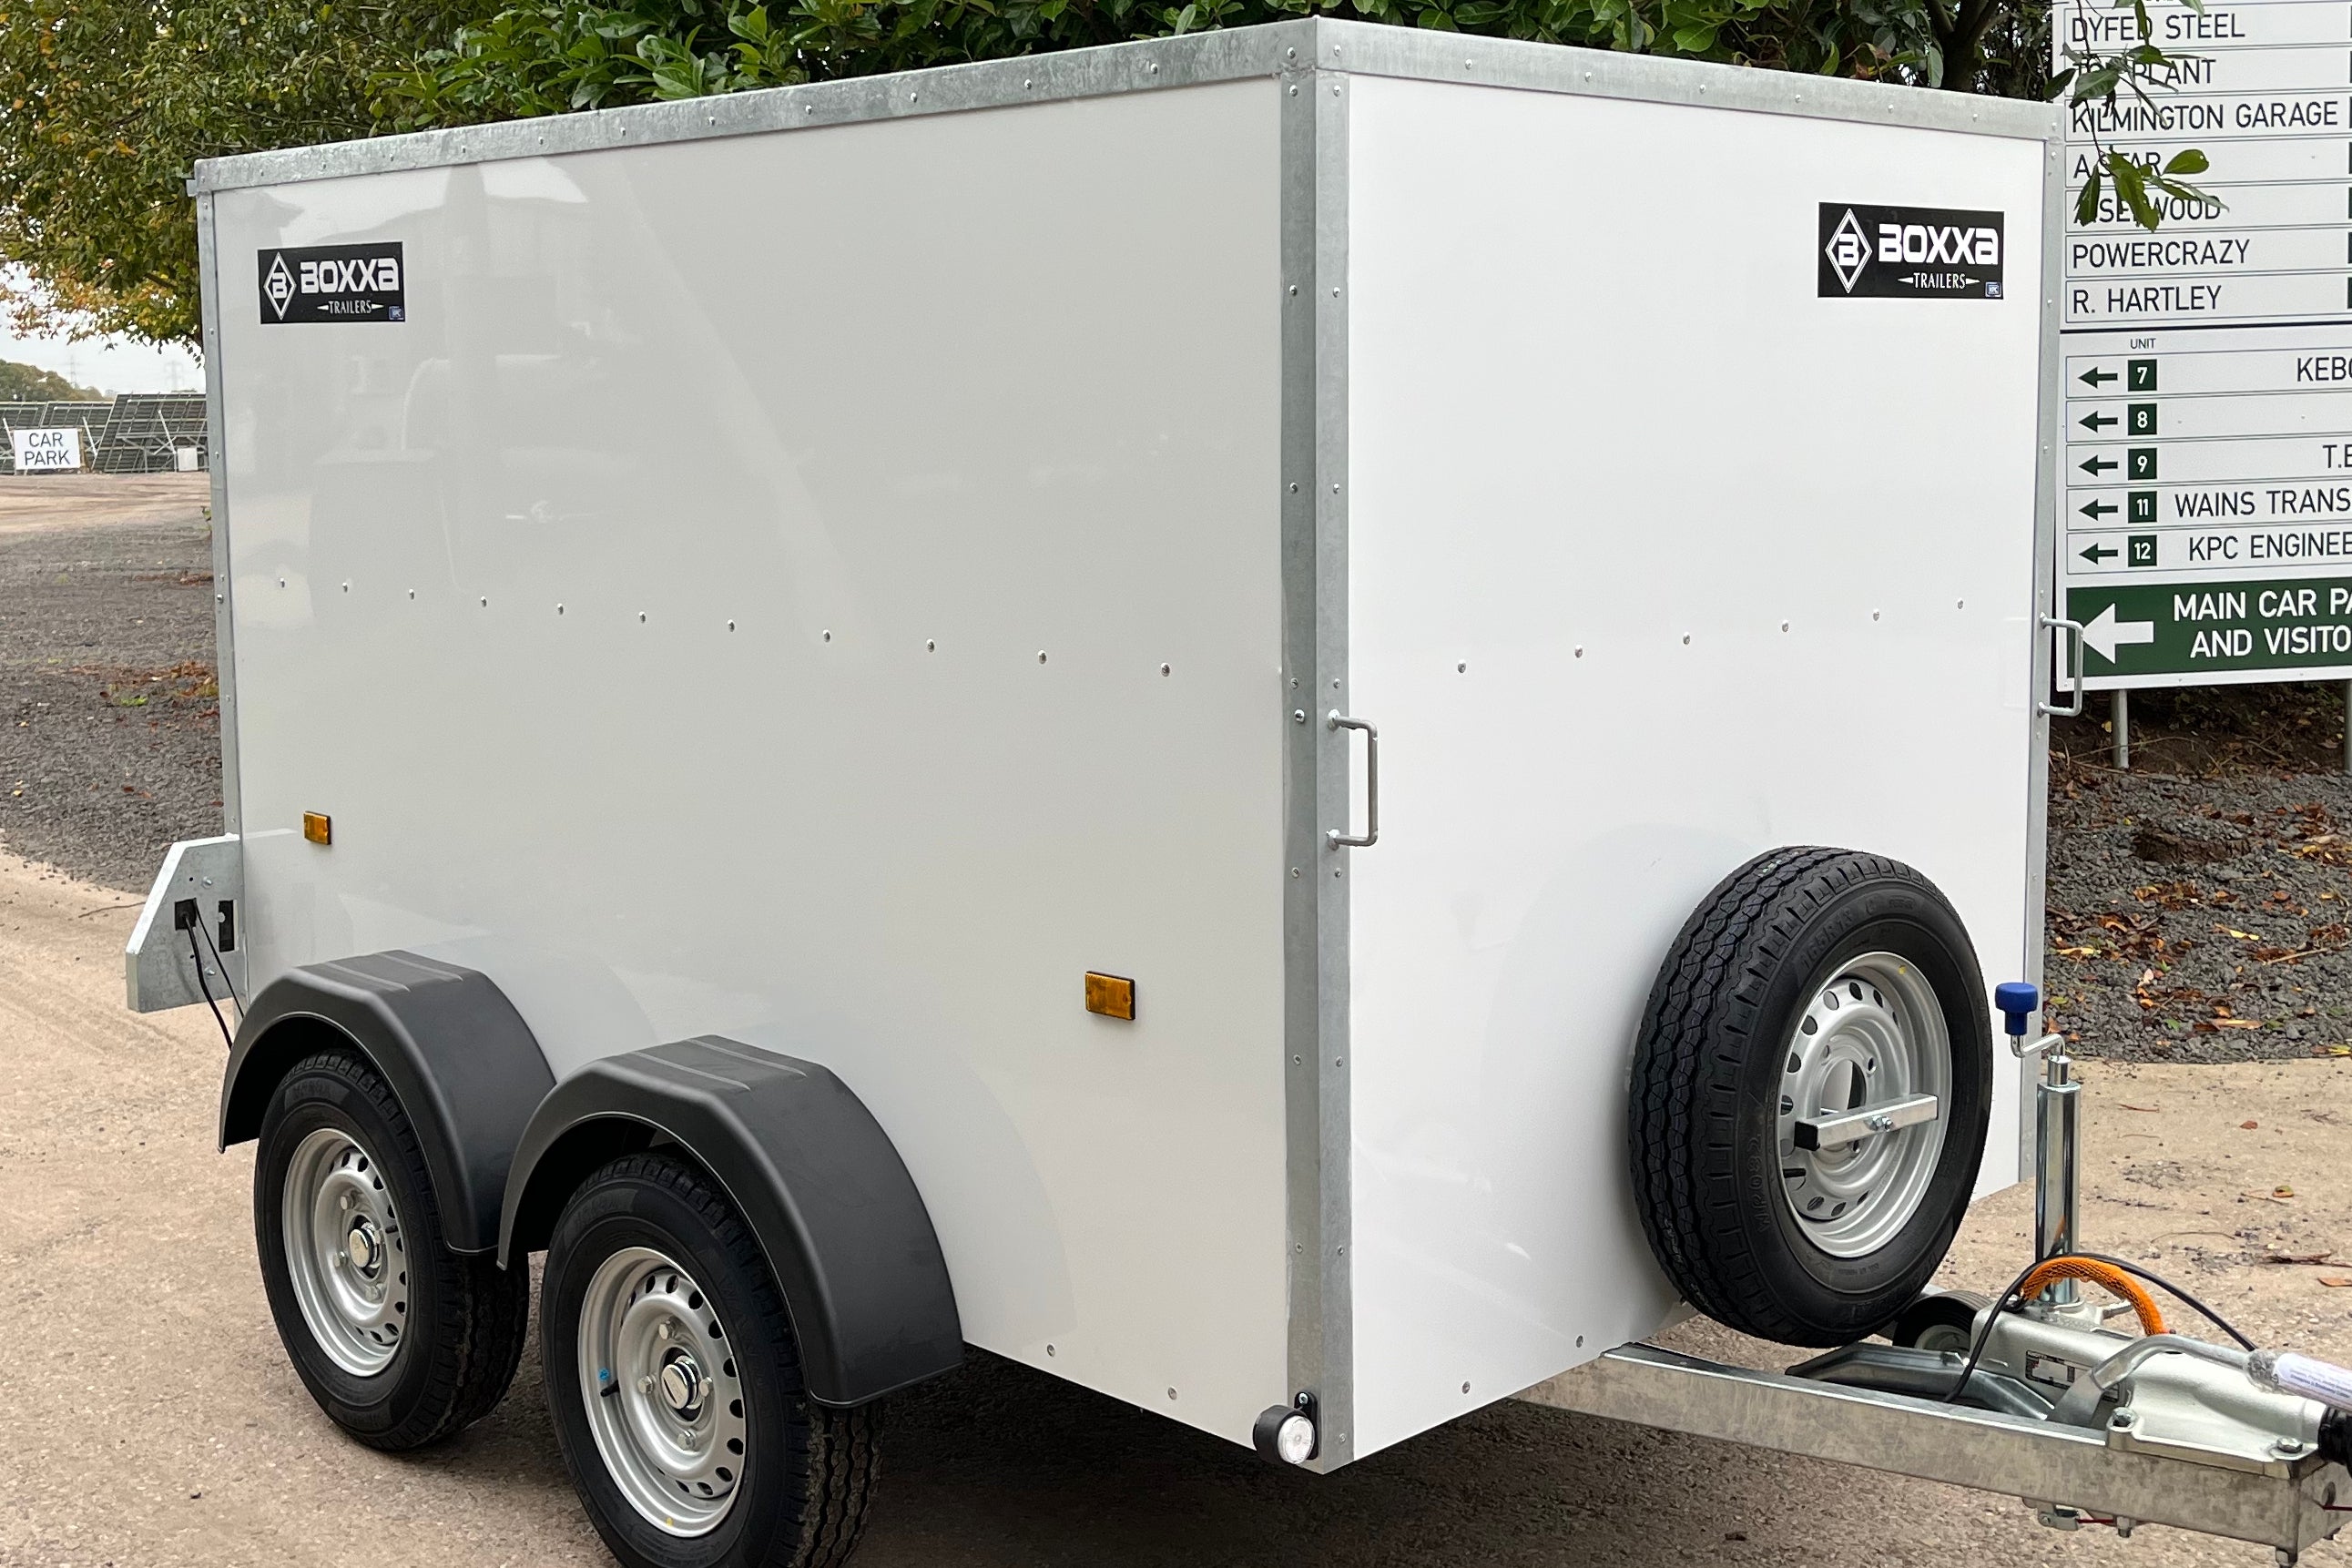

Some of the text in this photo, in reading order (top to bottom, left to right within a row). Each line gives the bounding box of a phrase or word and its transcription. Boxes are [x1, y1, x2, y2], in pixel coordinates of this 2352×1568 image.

[2072, 13, 2245, 42] DYFED STEEL
[2072, 101, 2338, 133] KILMINGTON GARAGE
[2072, 239, 2250, 269] POWERCRAZY
[1913, 272, 1966, 290] TRAILERS
[328, 300, 372, 314] TRAILERS
[2072, 285, 2222, 314] R. HARTLEY
[2130, 338, 2156, 350] UNIT
[2136, 356, 2352, 384] 7 KEB
[2136, 410, 2148, 428] 8
[28, 432, 64, 448] CAR
[25, 450, 71, 466] PARK
[2136, 454, 2148, 473] 9
[2136, 487, 2351, 517] 11 WAINS TRANS
[2133, 531, 2352, 561] 12 KPC ENGINEE
[2174, 592, 2246, 621] MAIN
[2259, 589, 2317, 617] CAR
[2190, 625, 2352, 658] AND VISITO
